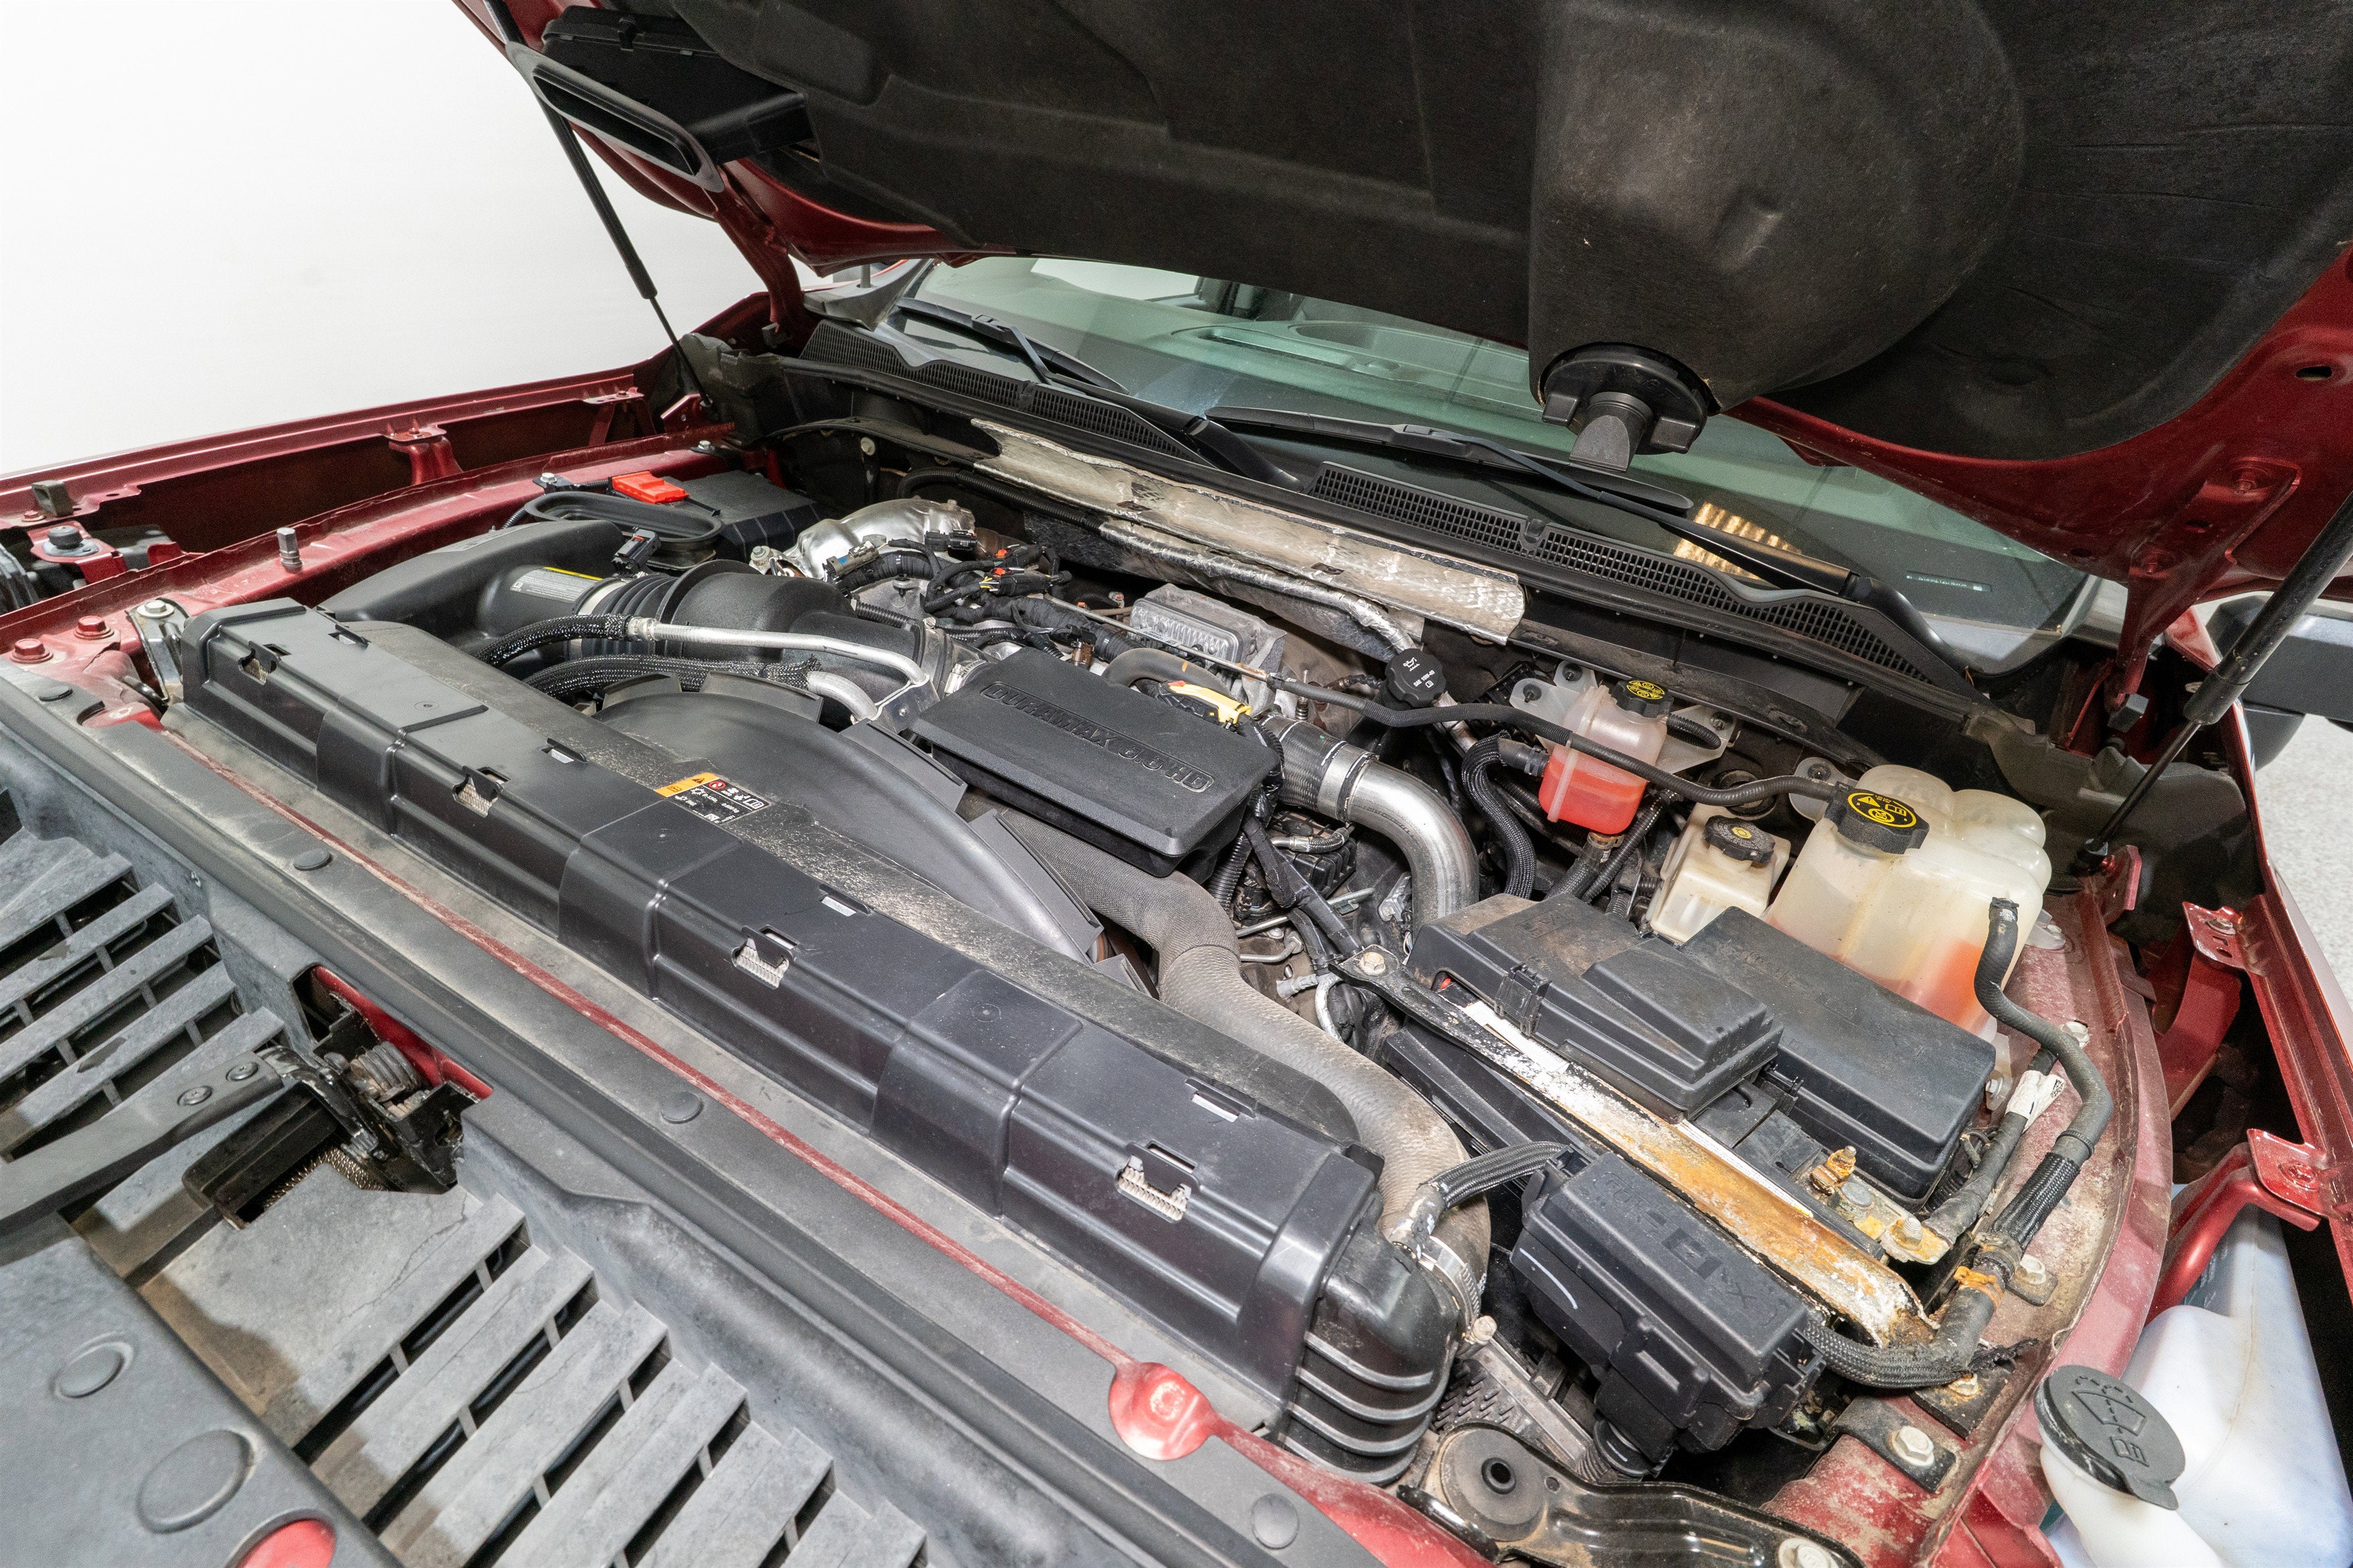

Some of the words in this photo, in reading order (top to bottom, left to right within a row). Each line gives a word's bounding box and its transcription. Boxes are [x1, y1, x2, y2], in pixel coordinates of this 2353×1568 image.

[1421, 670, 1435, 681] 15W-40
[983, 683, 1117, 748] DURAMAX
[1118, 744, 1166, 770] 6.6
[1164, 763, 1210, 790] HD
